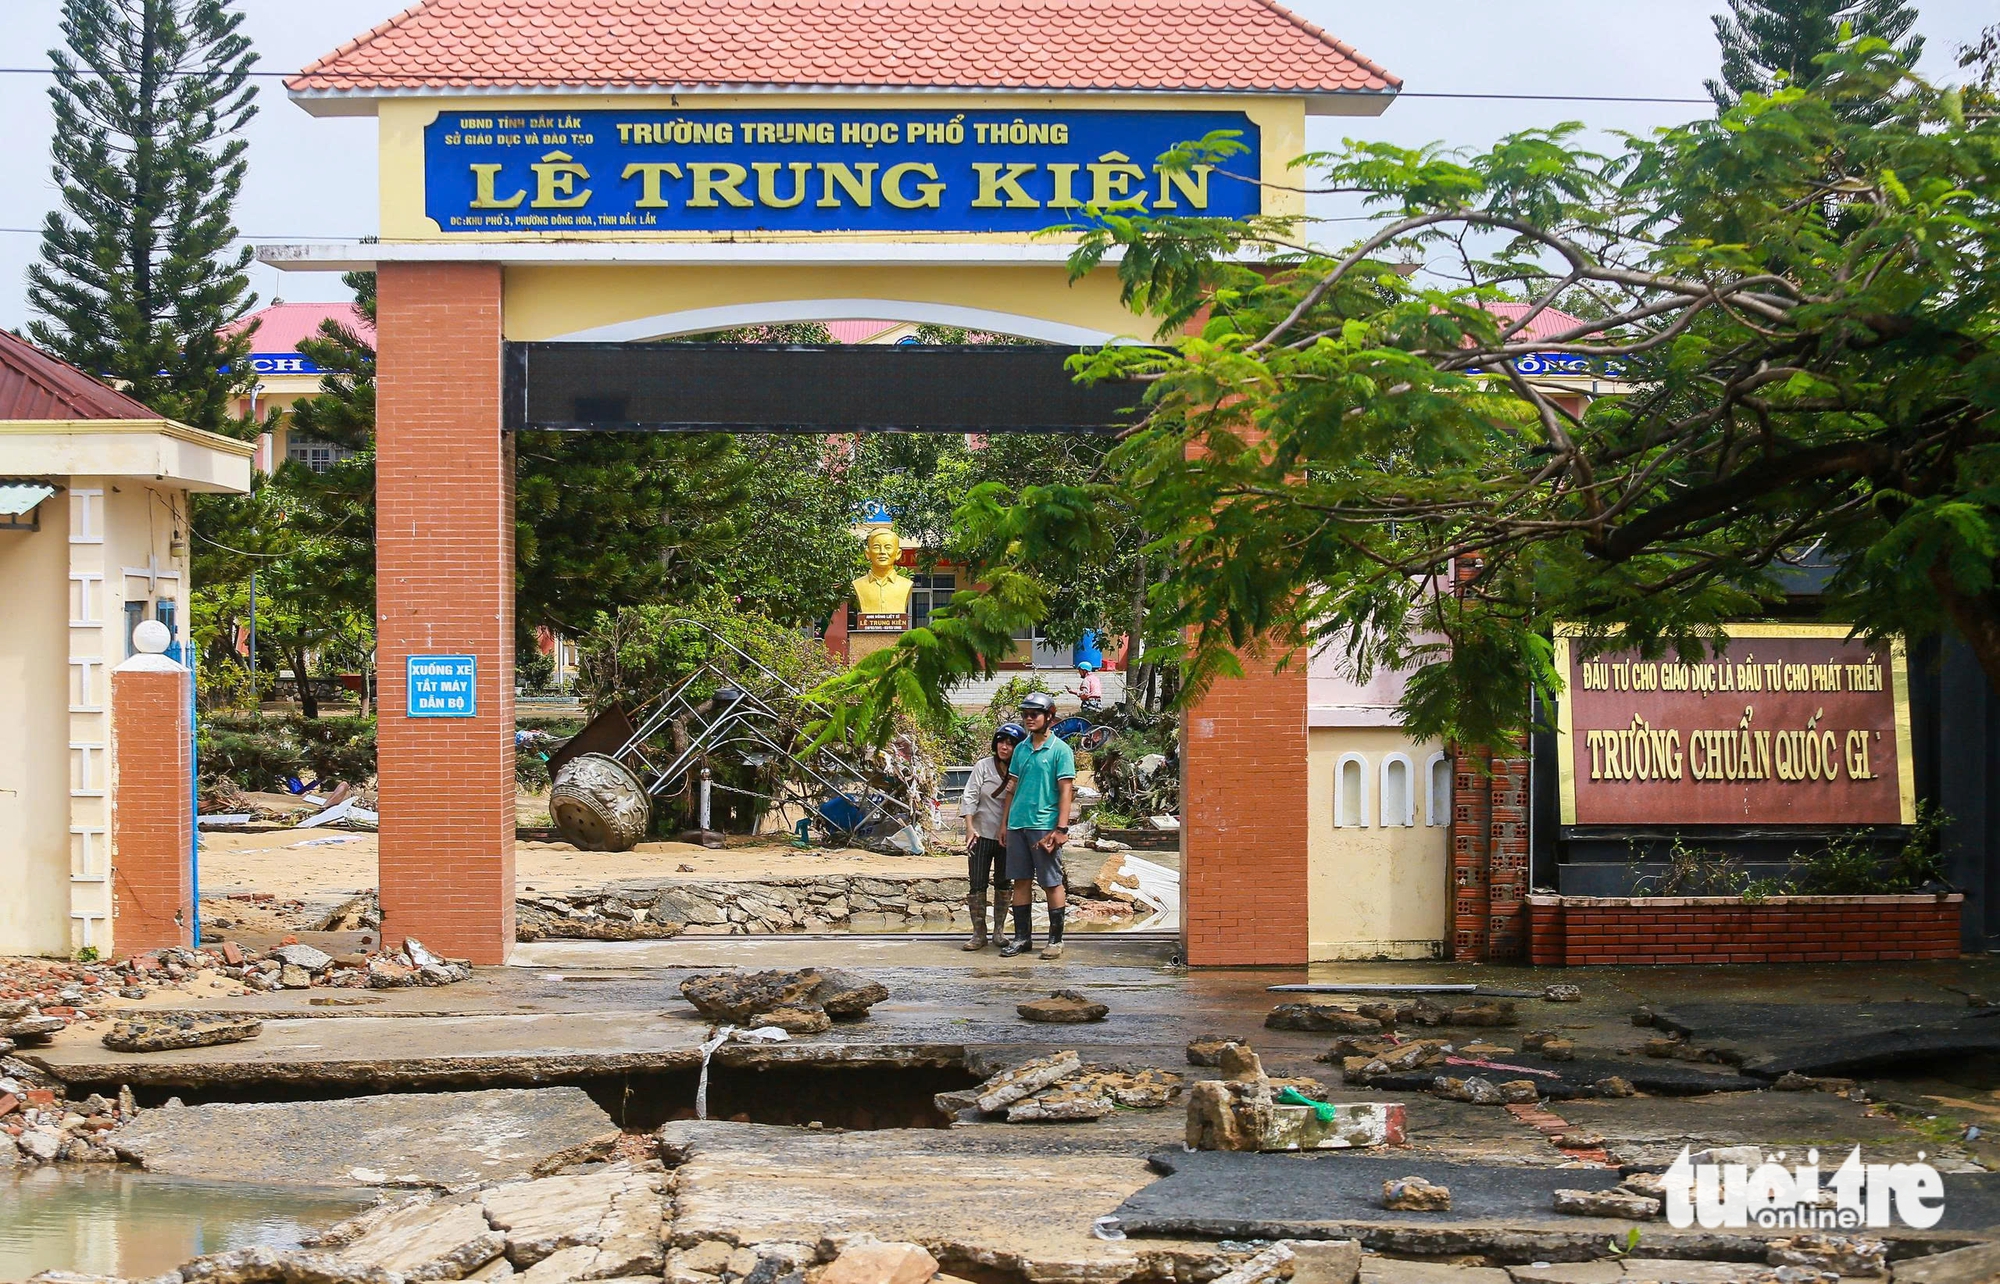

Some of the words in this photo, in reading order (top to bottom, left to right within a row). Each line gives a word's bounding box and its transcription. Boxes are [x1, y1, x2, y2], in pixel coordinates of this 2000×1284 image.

[460, 118, 493, 129] UBND
[497, 115, 525, 129] TỈNH
[616, 118, 733, 144] TRƯỜNG
[740, 122, 834, 144] TRUNG
[841, 122, 899, 148] HỌC
[907, 113, 965, 144] PHỔ
[973, 118, 1069, 144] THÔNG
[445, 131, 461, 145] SỞ
[464, 132, 493, 145] GIÁO
[497, 134, 521, 147] DỤC
[525, 132, 539, 145] VÀ
[543, 132, 567, 145] ĐÀO
[469, 149, 593, 208] LÊ
[620, 163, 945, 209] TRUNG
[971, 151, 1214, 209] KIÊN
[411, 662, 453, 676] XUỐNG
[456, 665, 472, 676] XE
[1612, 658, 1630, 691] TƯ
[1632, 662, 1658, 691] CHO
[1661, 656, 1689, 691] GIÁO
[1691, 663, 1716, 697] DỤC
[1718, 657, 1734, 691] LÀ
[1737, 653, 1762, 691] ĐẦU
[1764, 659, 1782, 691] TƯ
[1784, 663, 1809, 691] CHO
[1811, 658, 1842, 691] PHÁT
[416, 678, 438, 692] TẮT
[441, 679, 467, 692] MÁY
[419, 694, 444, 709] DẪN
[448, 696, 465, 711] BỘ
[1587, 712, 1683, 781] TRƯỜNG
[1689, 706, 1771, 781] CHUẨN
[1775, 707, 1838, 780] QUỐC
[1846, 730, 1880, 779] GI
